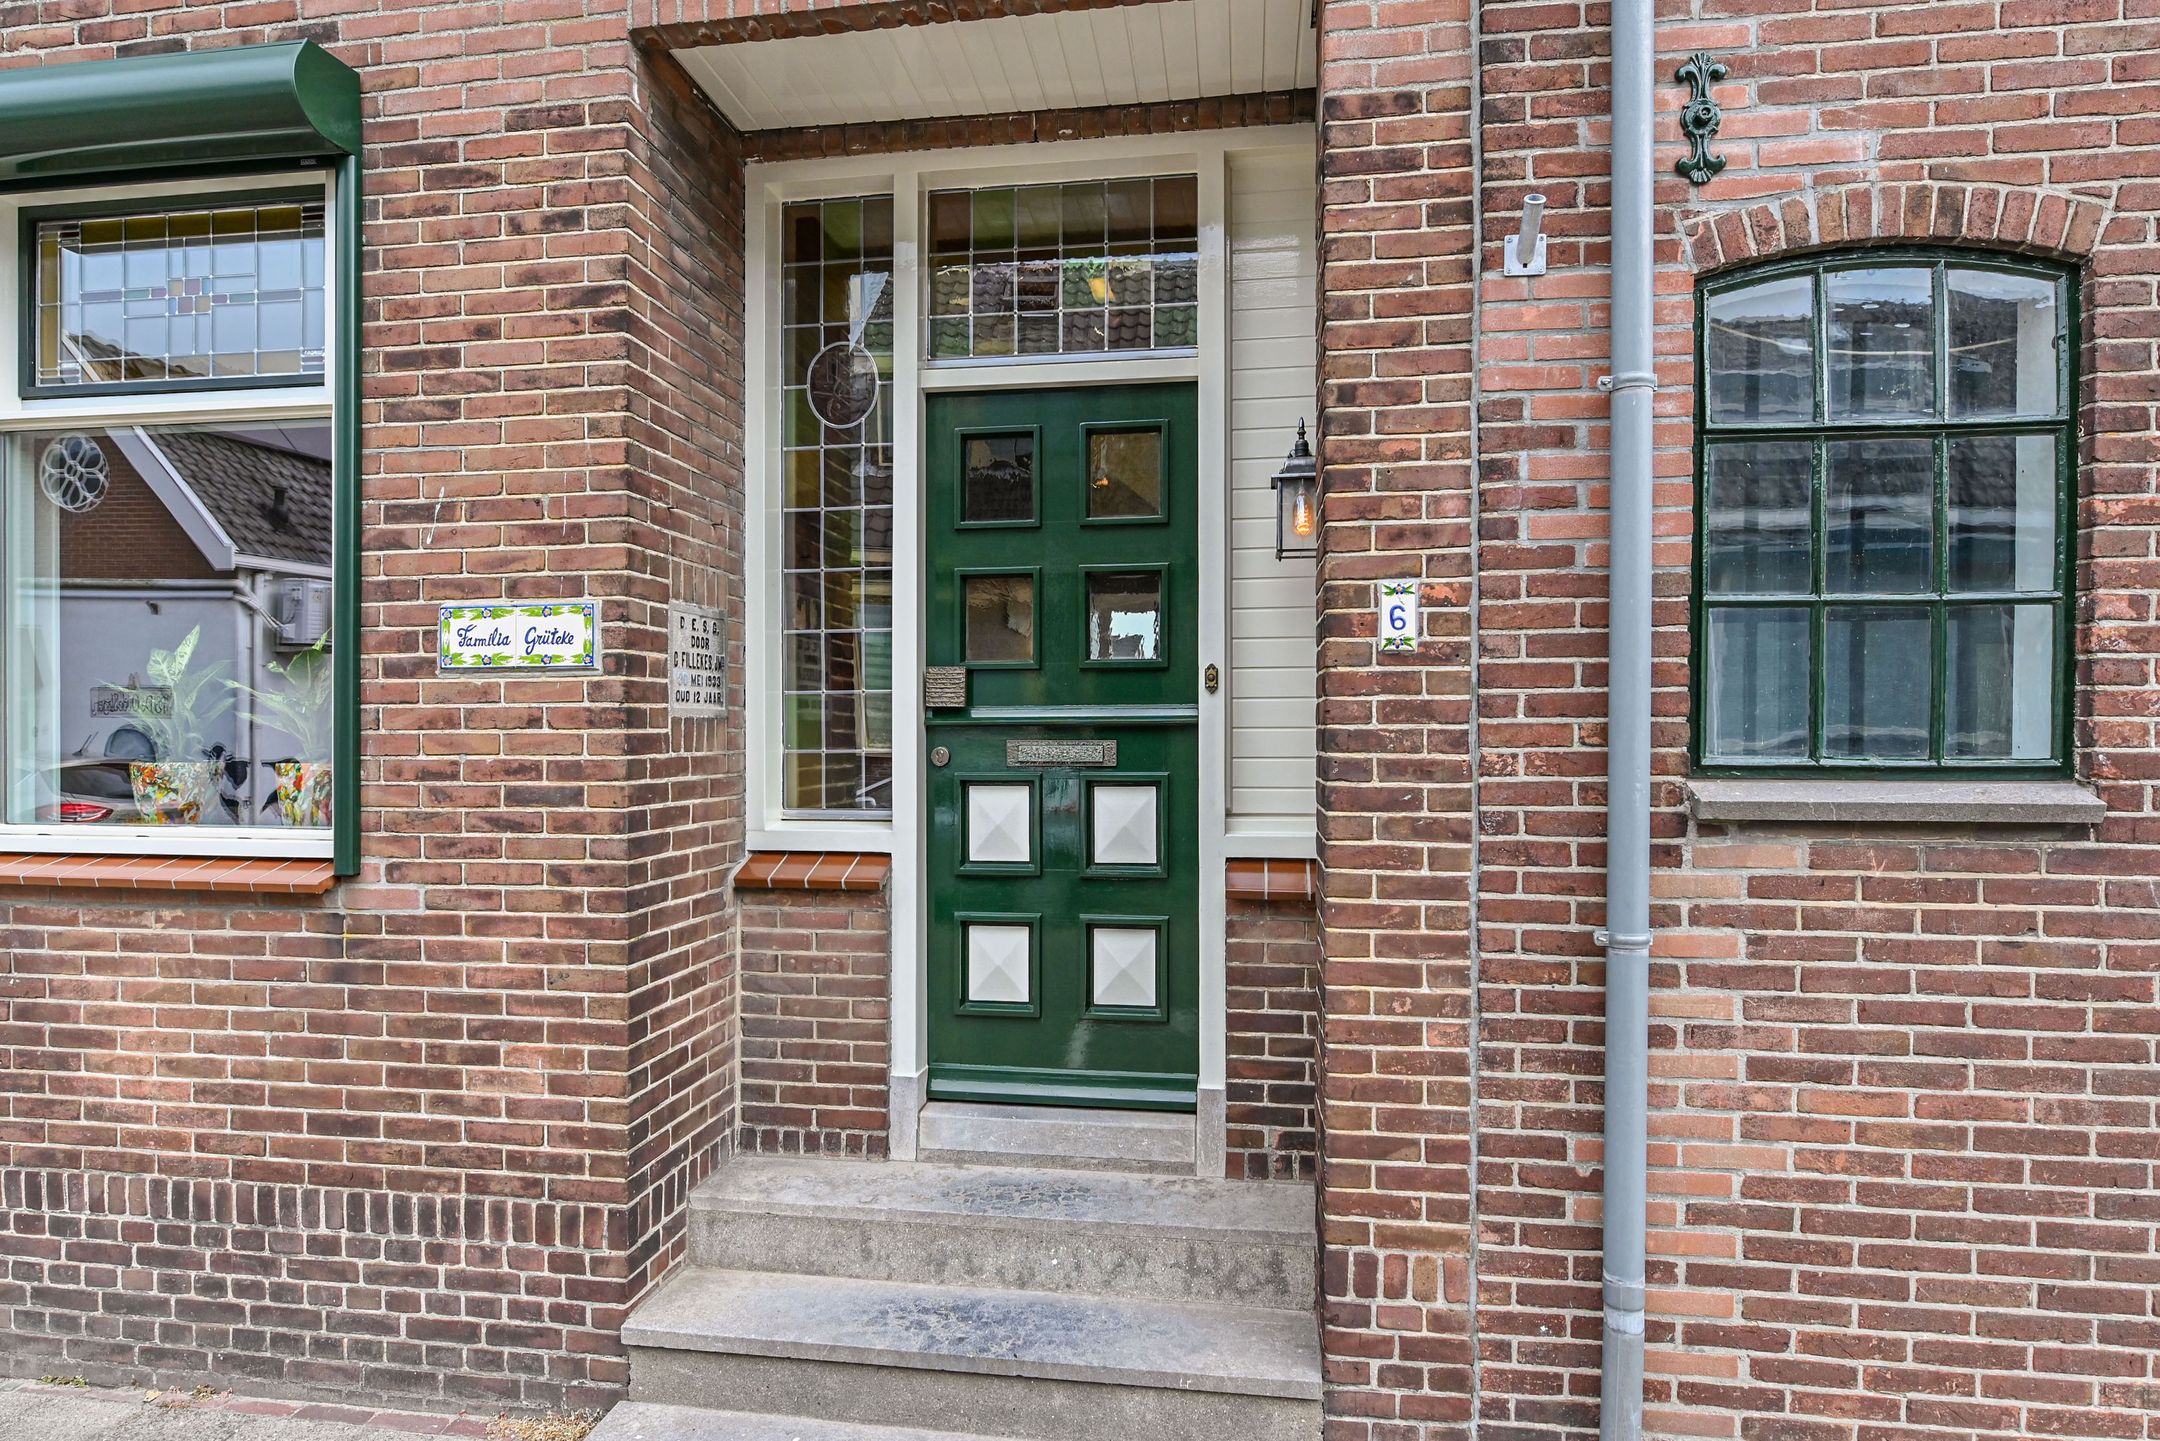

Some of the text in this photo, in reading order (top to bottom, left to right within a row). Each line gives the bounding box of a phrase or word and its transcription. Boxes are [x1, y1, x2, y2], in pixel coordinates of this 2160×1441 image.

[1389, 604, 1407, 630] 6
[691, 636, 710, 650] DOOR
[691, 674, 703, 687] MEI
[705, 676, 721, 688] 1933
[675, 690, 690, 703] OUD
[693, 691, 701, 704] 12
